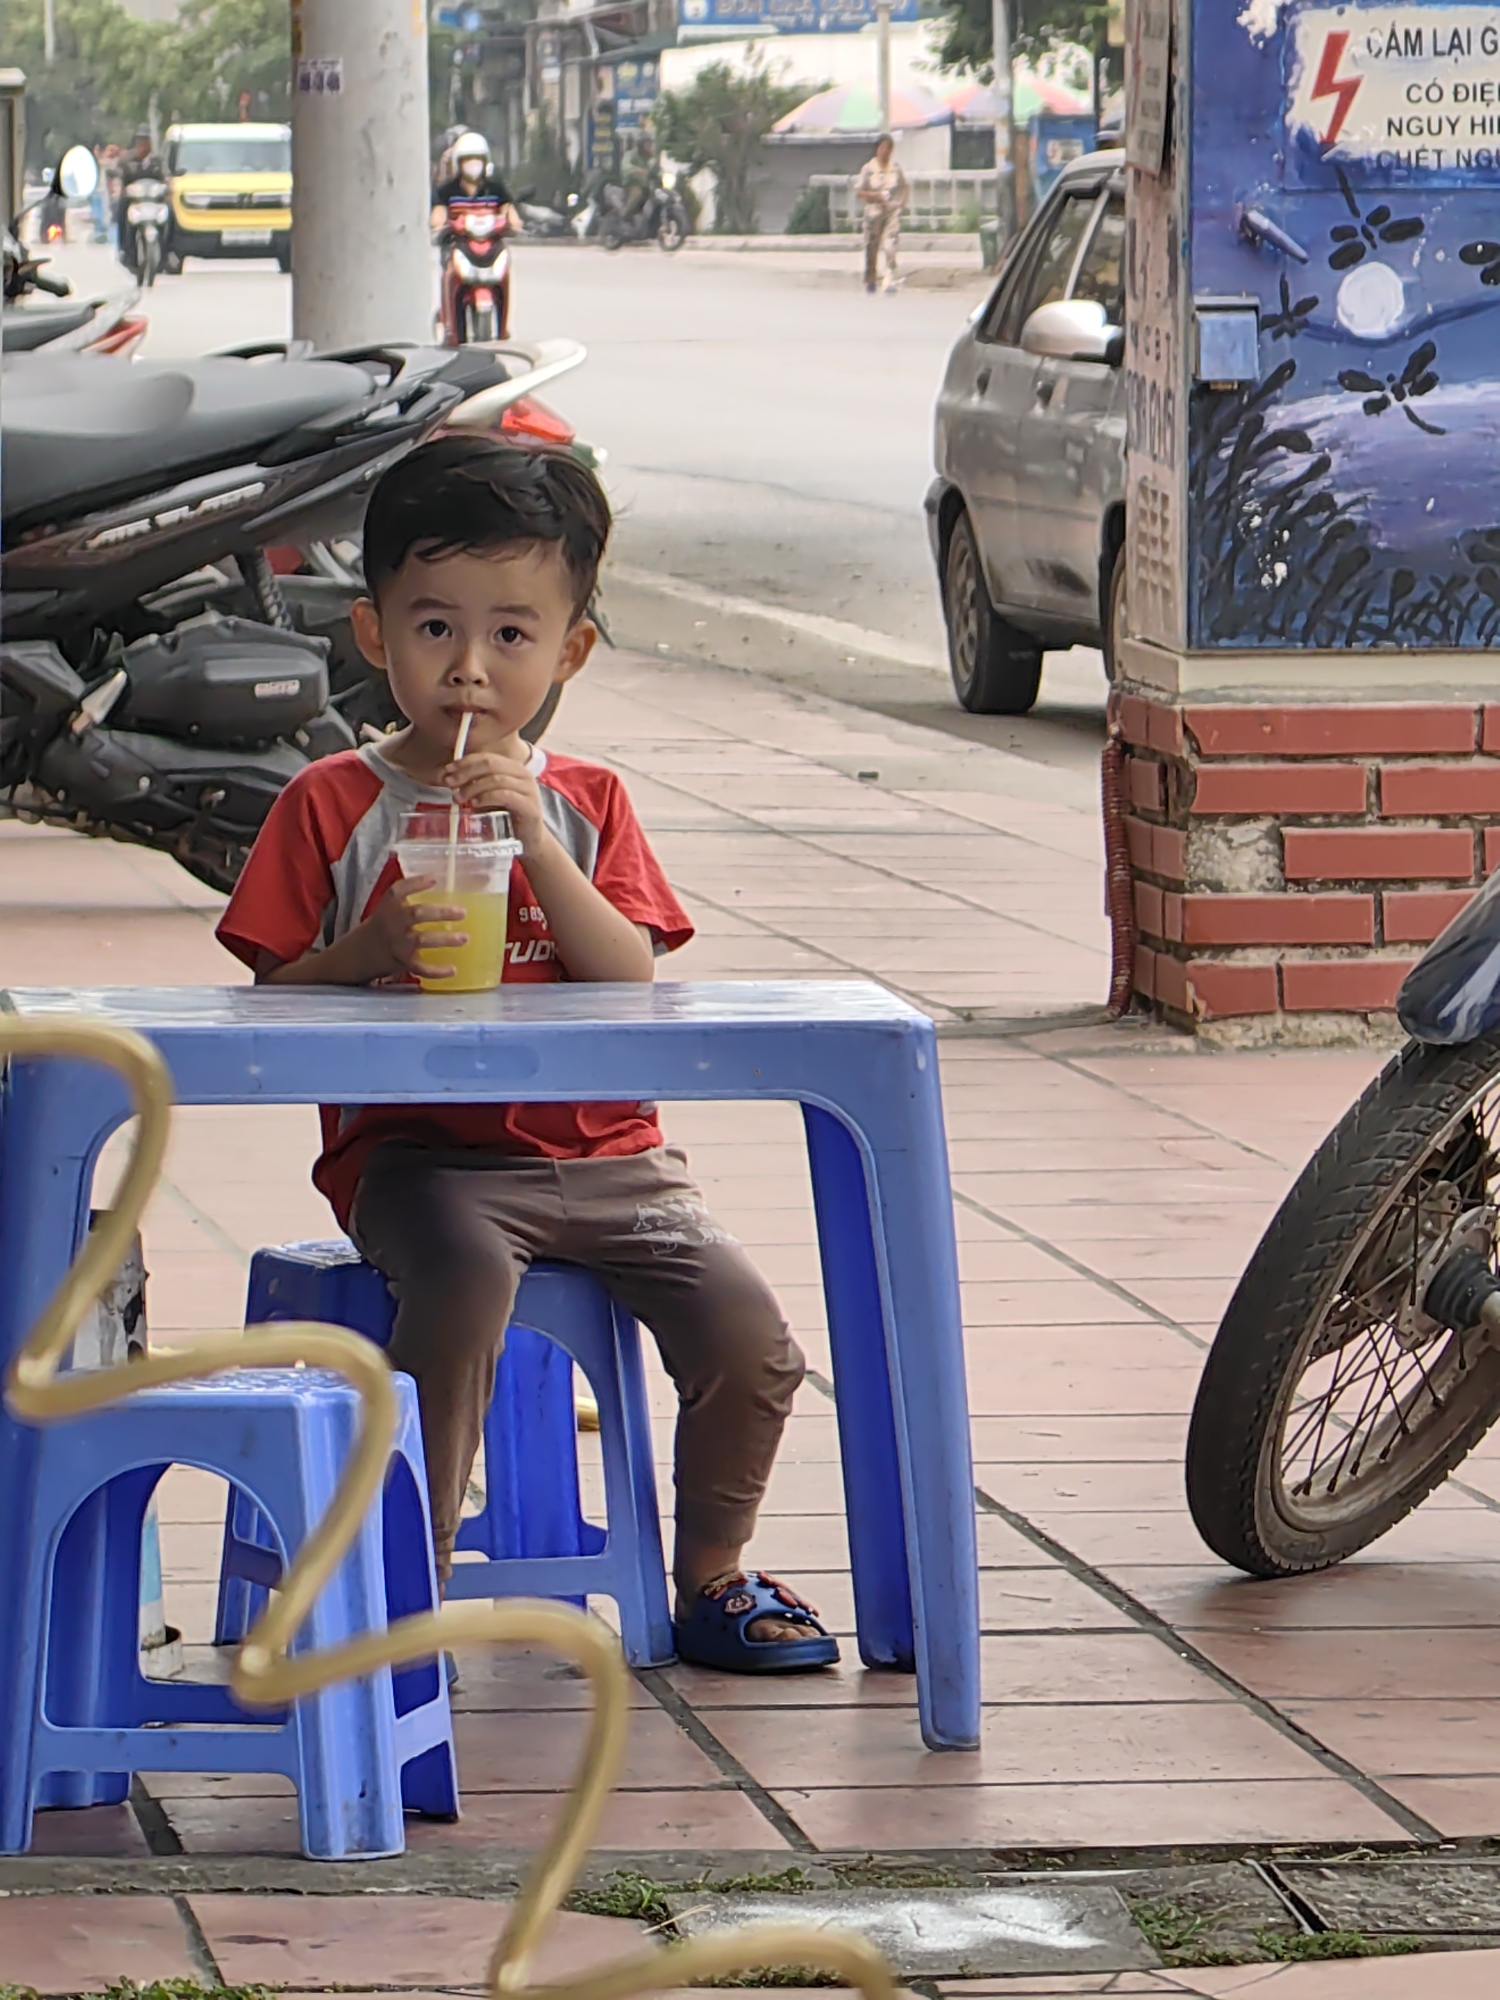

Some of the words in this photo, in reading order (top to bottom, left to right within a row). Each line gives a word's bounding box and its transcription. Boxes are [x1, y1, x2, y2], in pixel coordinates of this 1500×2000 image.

[1432, 26, 1471, 64] LẠI
[1406, 77, 1444, 104] CÓ
[1452, 79, 1500, 108] ĐIỆ
[1387, 115, 1461, 137] NGUY
[1470, 115, 1500, 136] HI
[1456, 147, 1500, 169] NG
